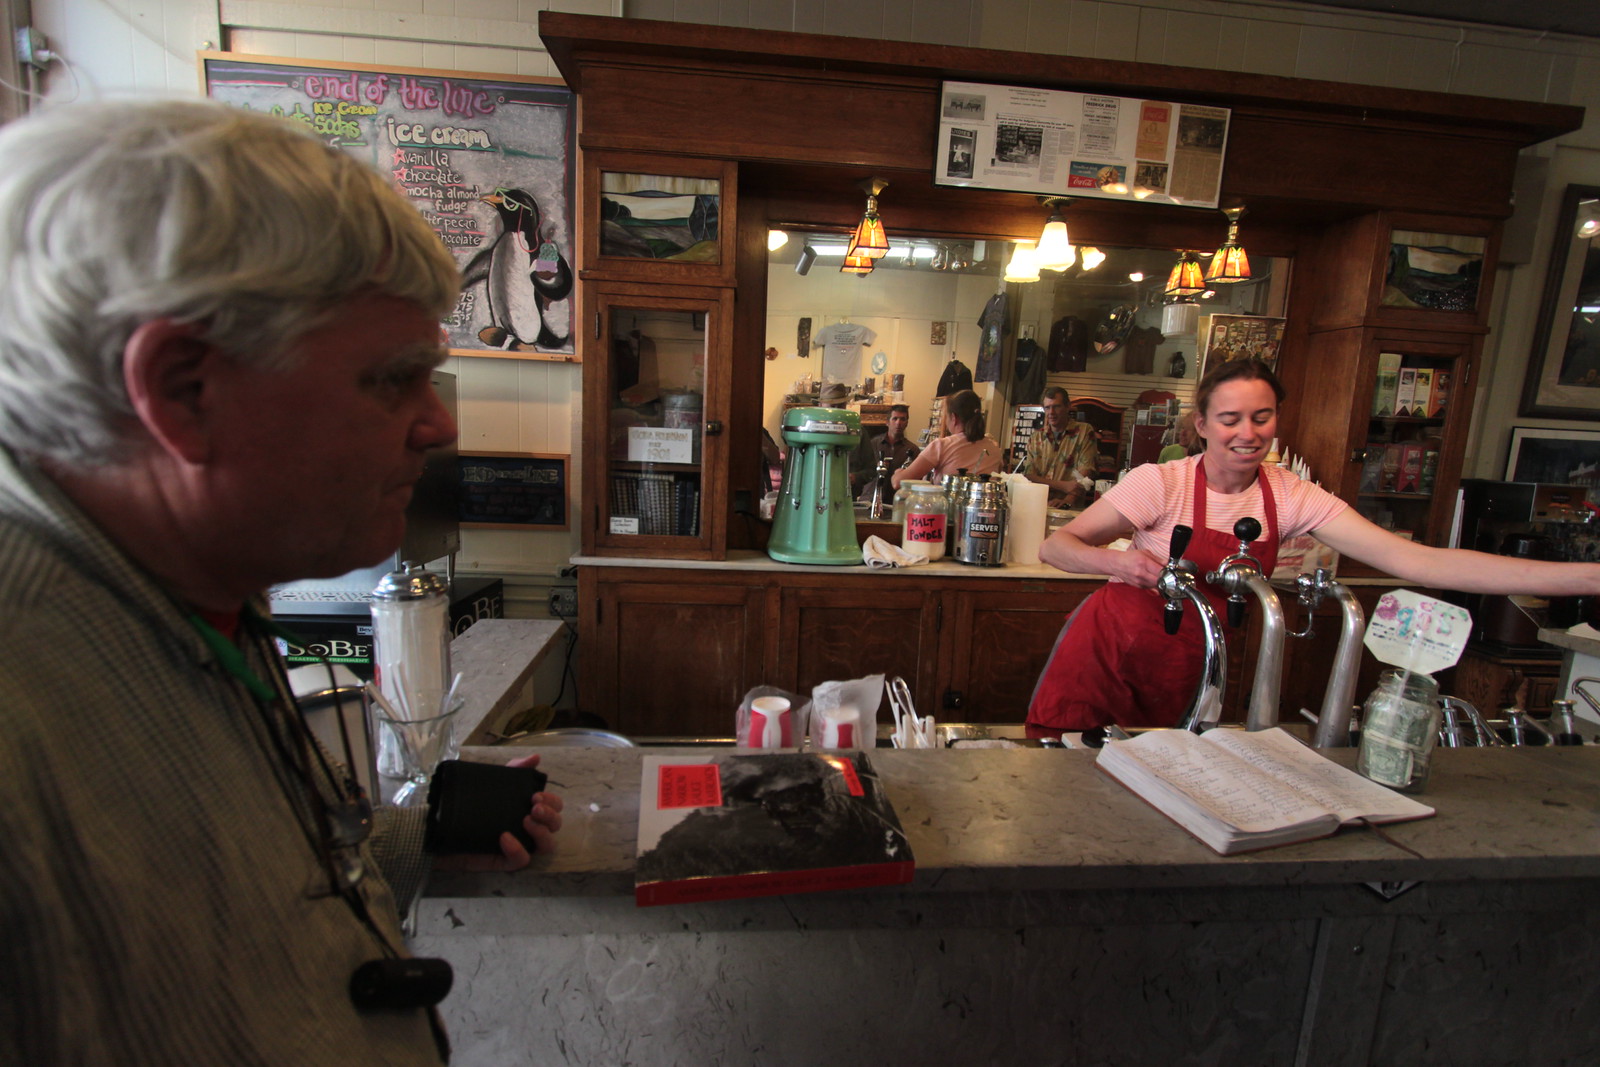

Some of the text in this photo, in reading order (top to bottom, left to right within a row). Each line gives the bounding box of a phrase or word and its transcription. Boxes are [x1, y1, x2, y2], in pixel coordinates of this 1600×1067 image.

[304, 74, 496, 118] end of the line
[387, 117, 491, 149] ice cream
[404, 149, 449, 167] vanilla
[407, 186, 480, 199] mocha almond
[435, 200, 467, 214] fudge
[444, 218, 477, 232] pecan
[441, 232, 480, 246] hocolate
[912, 518, 935, 528] MALT
[970, 523, 999, 532] SERVER
